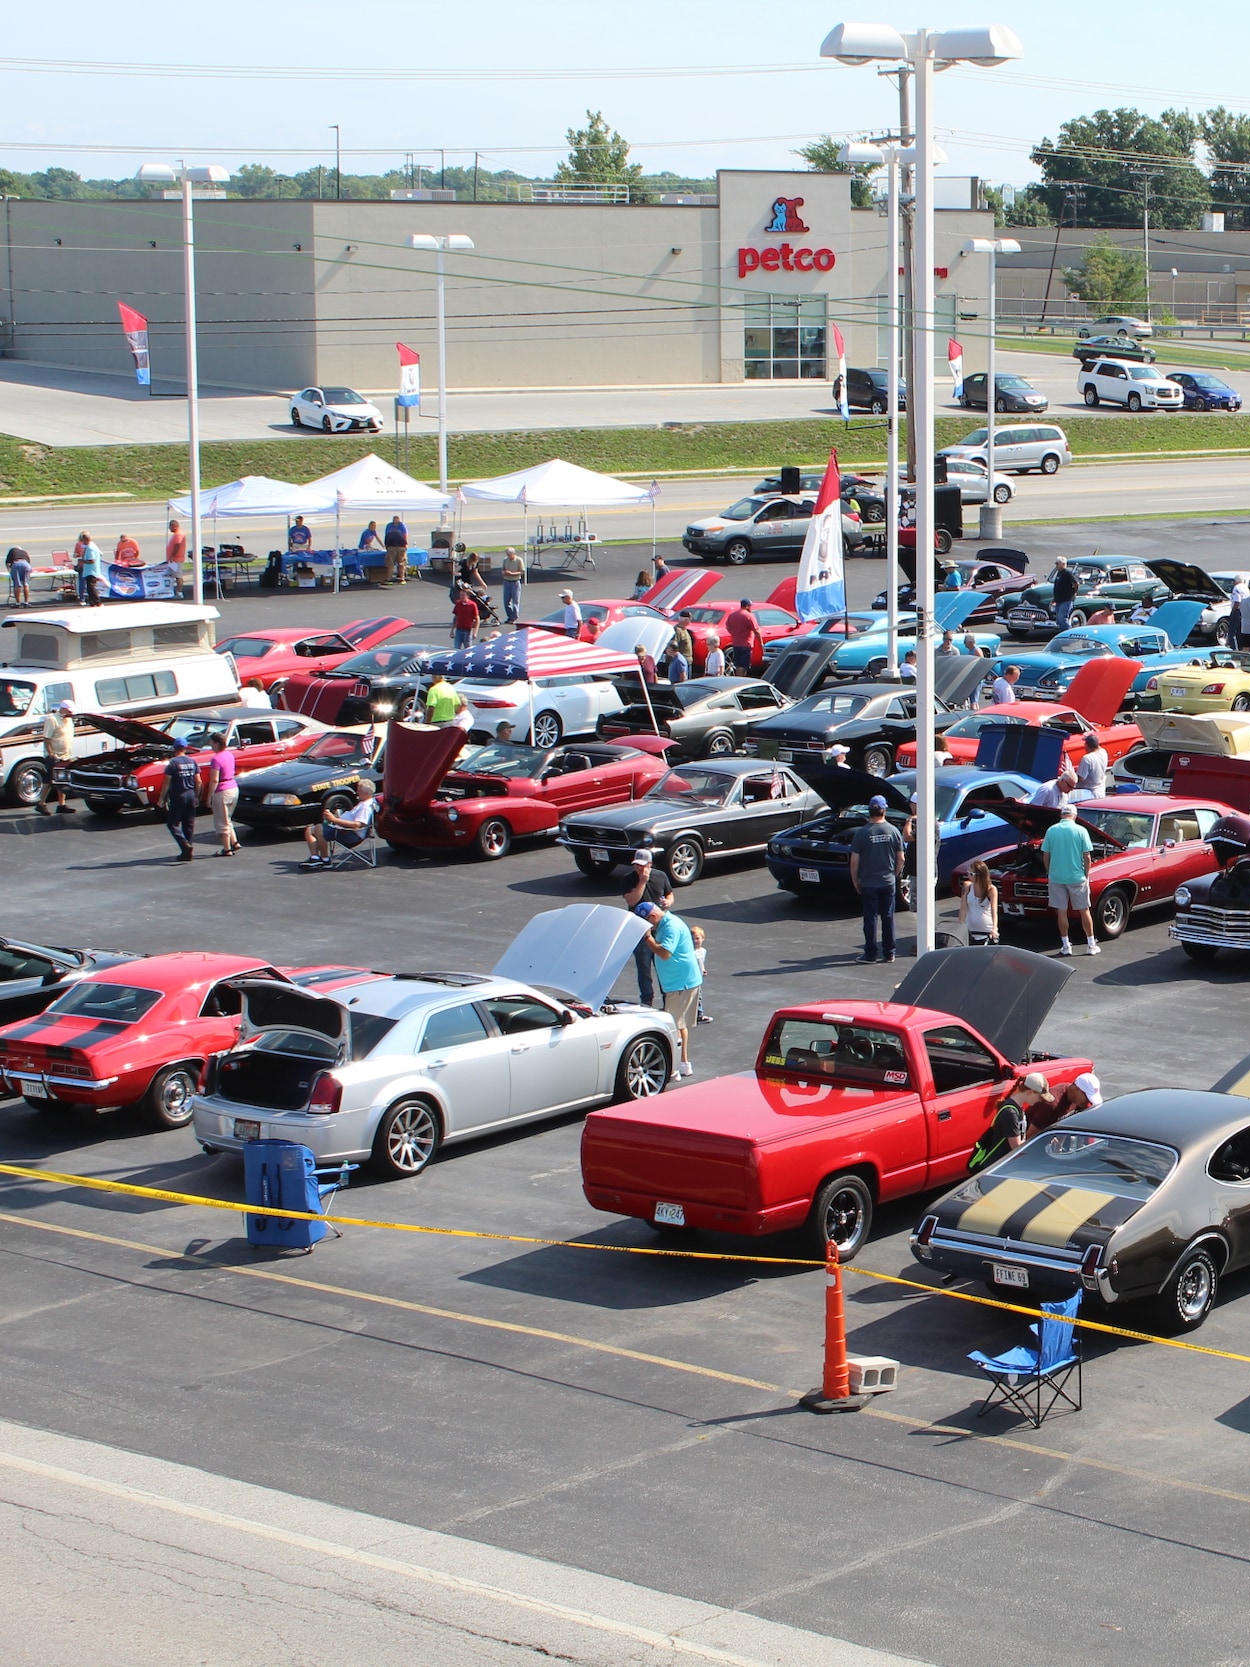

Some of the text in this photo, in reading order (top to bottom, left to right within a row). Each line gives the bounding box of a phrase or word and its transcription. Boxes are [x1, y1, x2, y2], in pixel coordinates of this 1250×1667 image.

[738, 243, 836, 279] petco
[311, 775, 361, 793] STATE TROOPER
[765, 1055, 787, 1066] JEGS
[886, 1071, 906, 1080] MSD
[1017, 1271, 1026, 1283] 69
